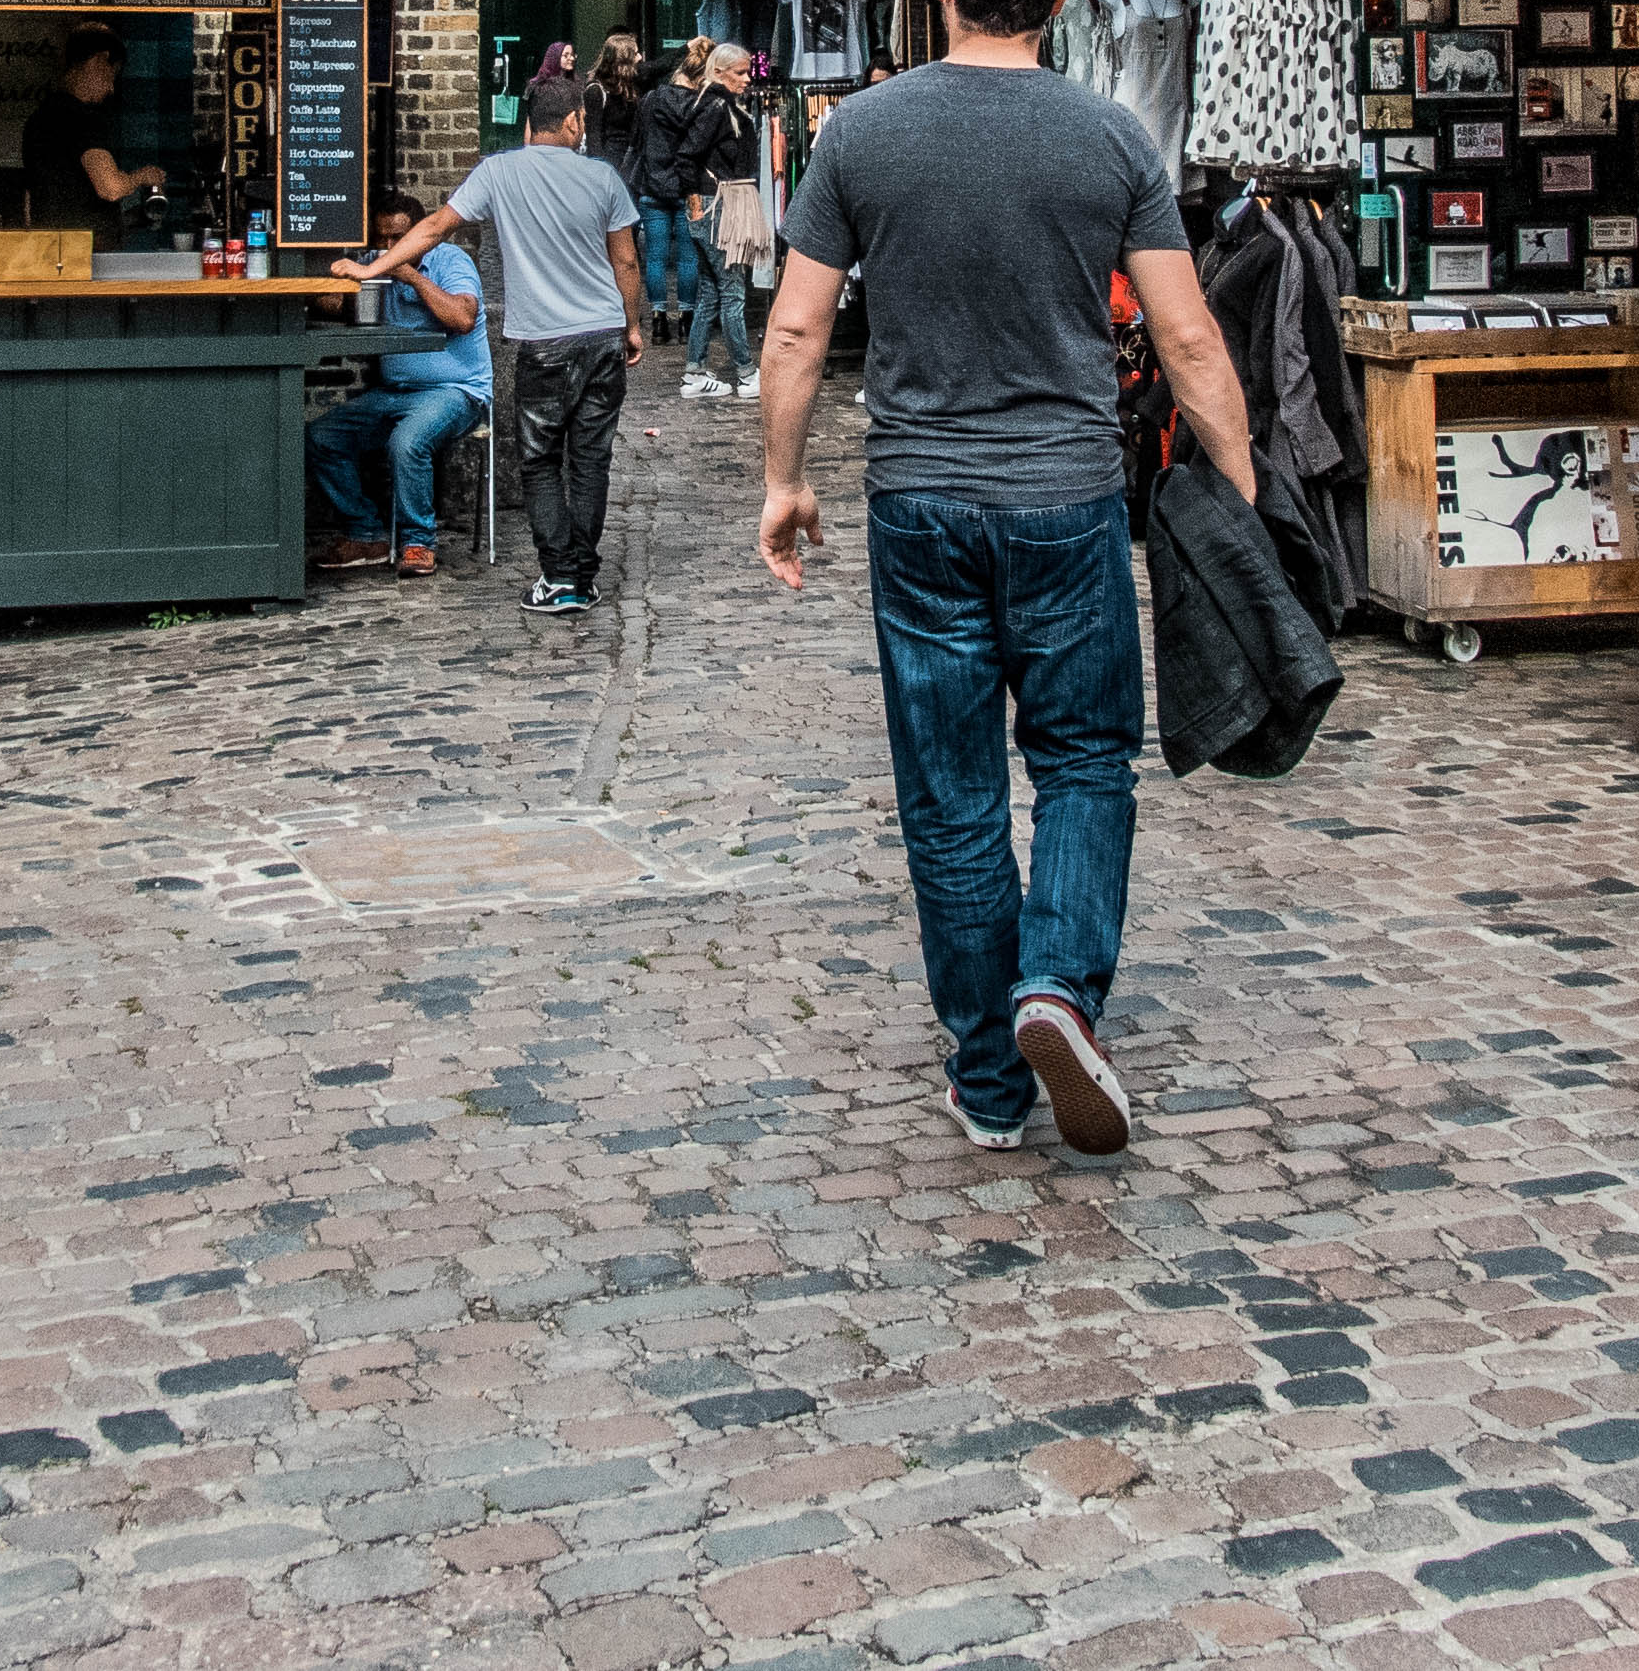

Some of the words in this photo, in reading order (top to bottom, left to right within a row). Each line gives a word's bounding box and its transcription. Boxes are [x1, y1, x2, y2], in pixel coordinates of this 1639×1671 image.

[289, 16, 331, 26] Espresso
[311, 38, 357, 48] Macchiato
[289, 61, 310, 70] Dble
[313, 61, 355, 71] Espresso
[289, 83, 345, 94] Cappuccino
[315, 105, 340, 115] Latte
[289, 126, 342, 134] Americano
[289, 149, 307, 158] Hot
[309, 149, 354, 159] Chocolate
[288, 171, 305, 181] Tea
[288, 194, 310, 202] Cold
[313, 194, 346, 202] Drinks
[290, 223, 311, 232] 1.50
